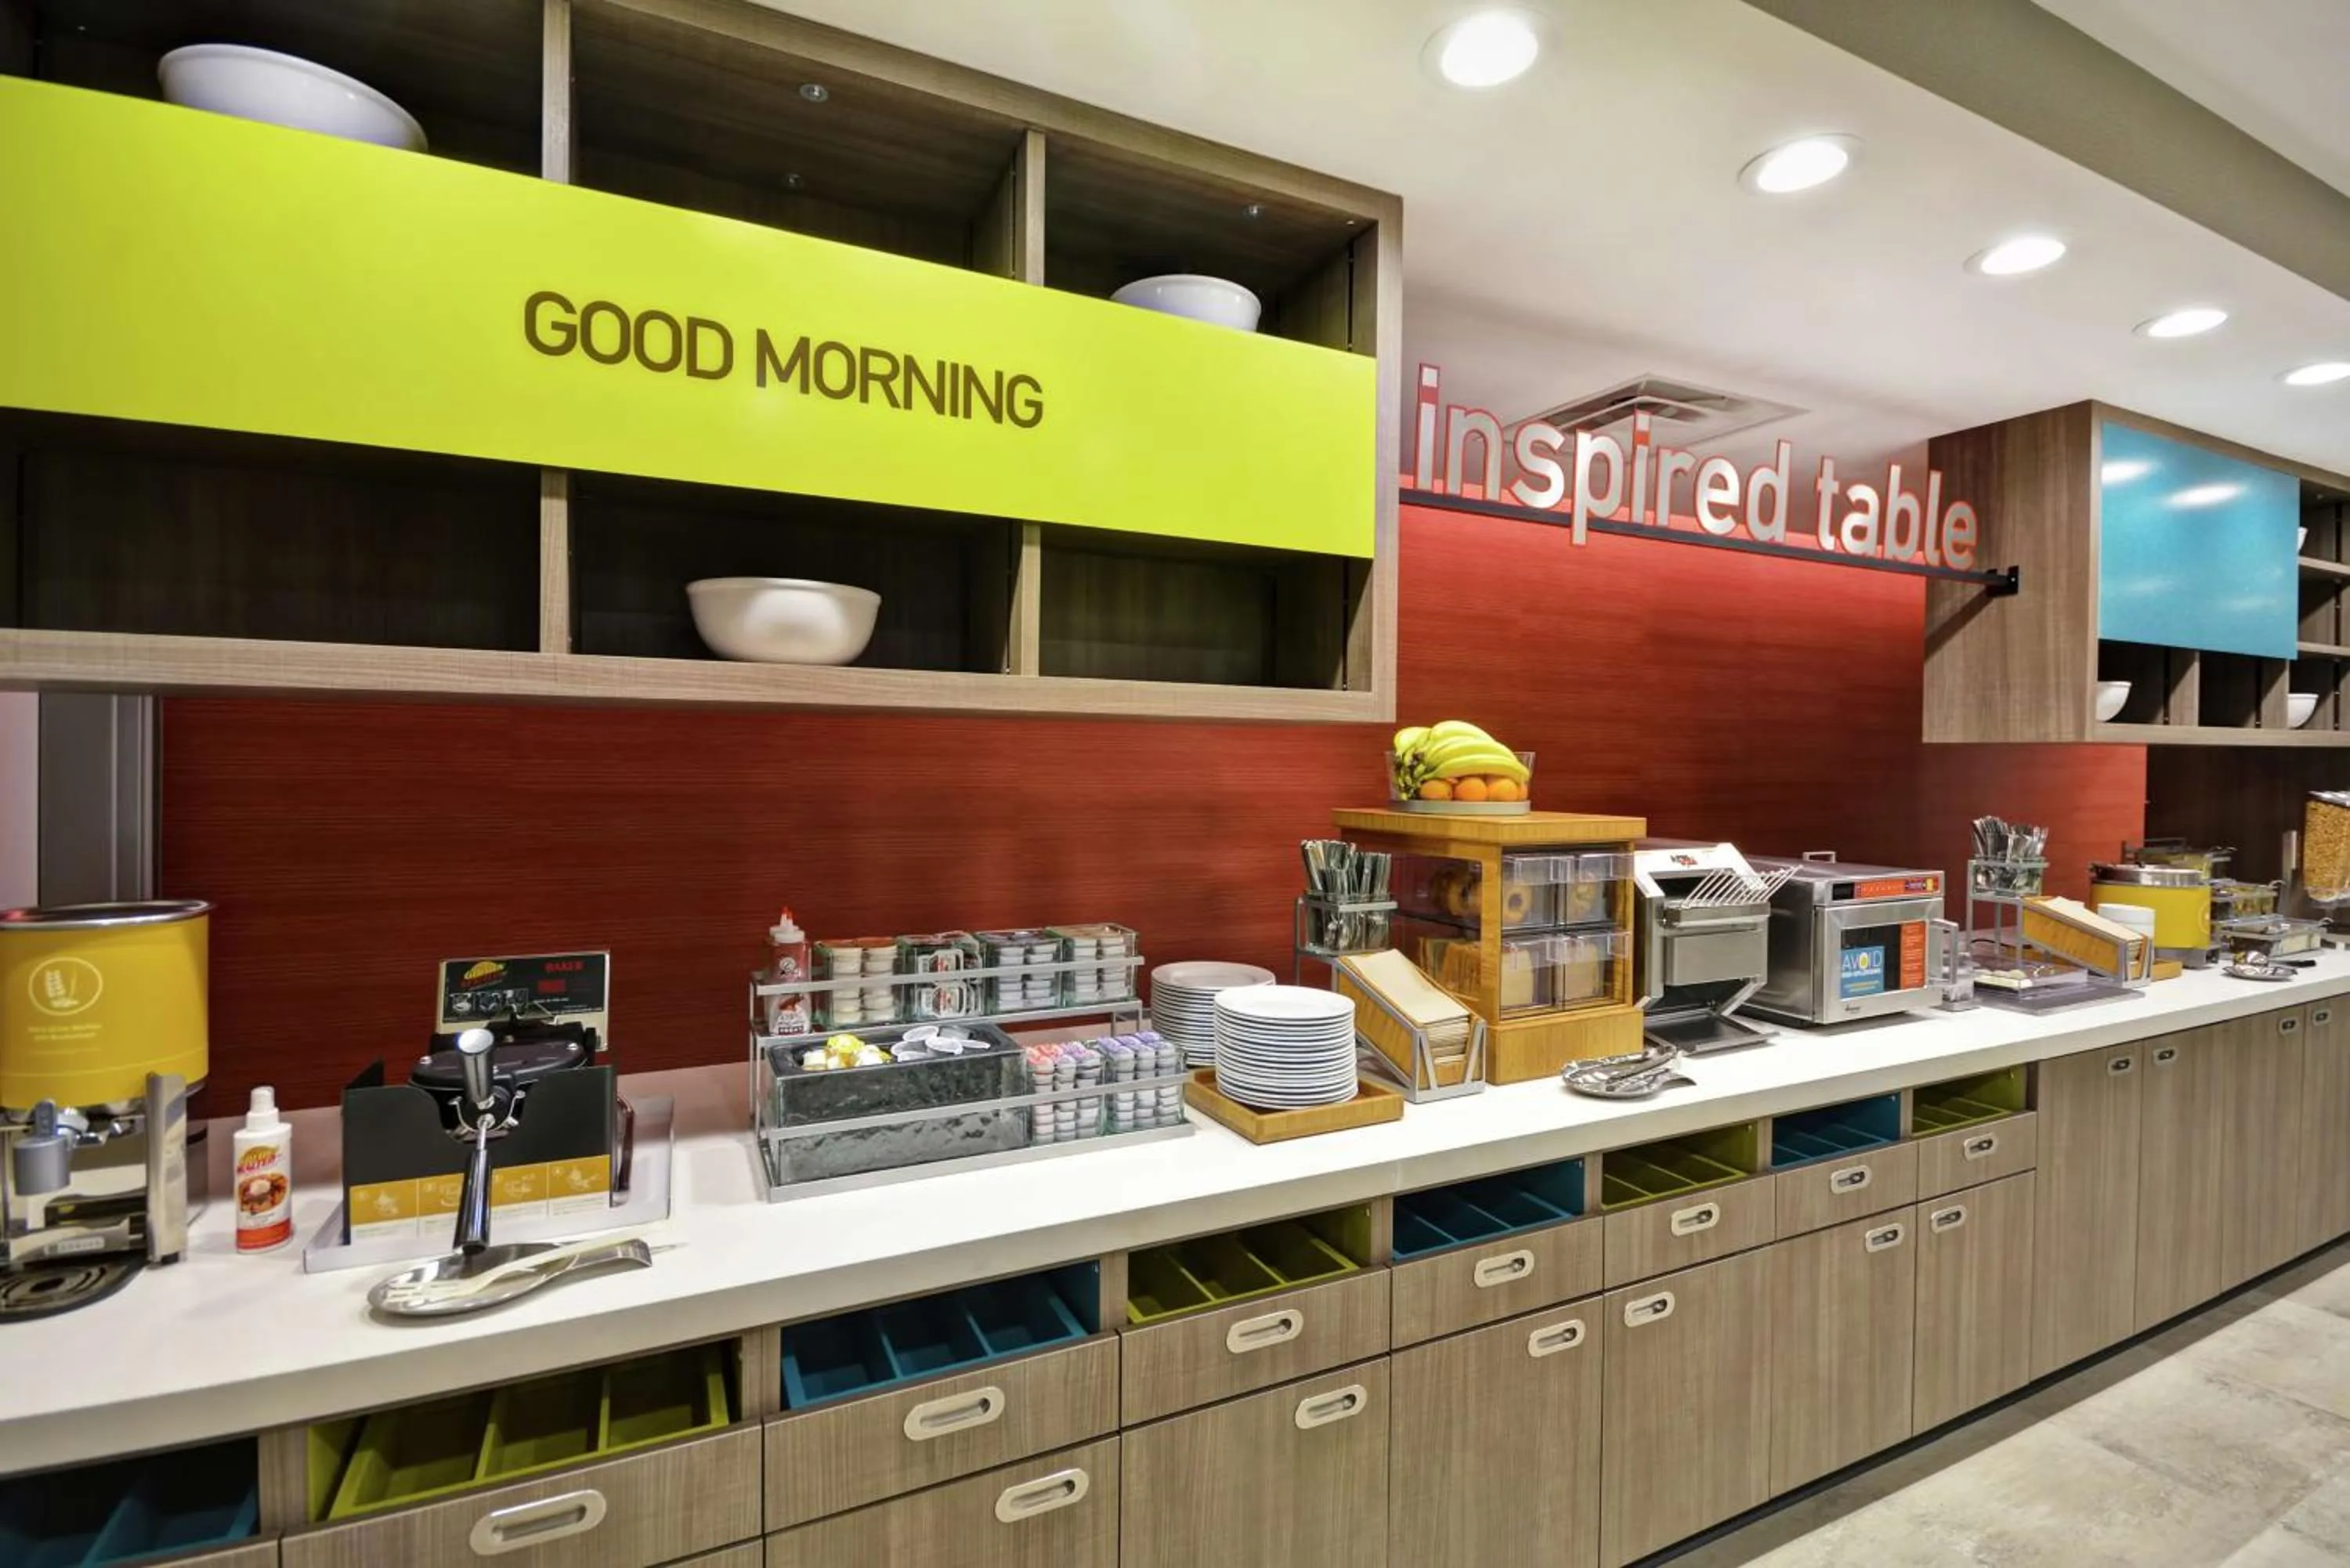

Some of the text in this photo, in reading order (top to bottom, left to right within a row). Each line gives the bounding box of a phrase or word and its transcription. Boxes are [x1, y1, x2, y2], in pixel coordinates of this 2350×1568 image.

[524, 291, 1043, 428] GOOD MORNING
[1414, 363, 1978, 570] inspired table
[1842, 950, 1882, 970] AVOID
